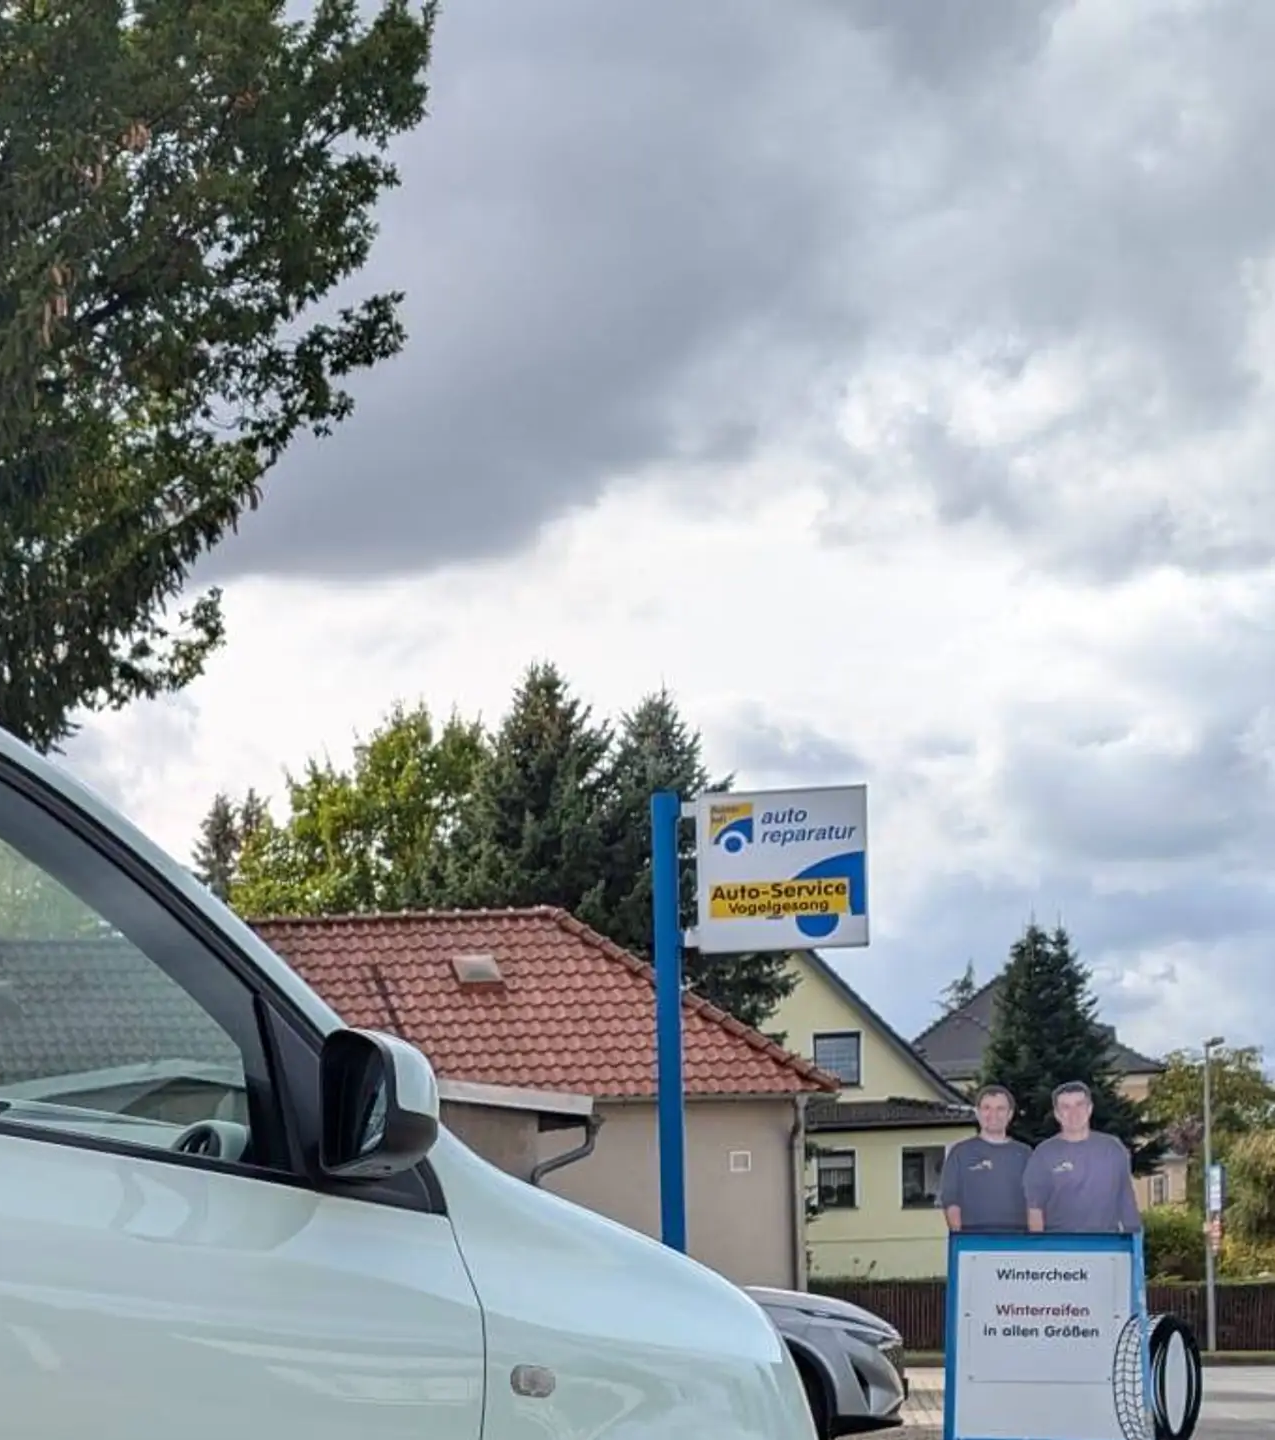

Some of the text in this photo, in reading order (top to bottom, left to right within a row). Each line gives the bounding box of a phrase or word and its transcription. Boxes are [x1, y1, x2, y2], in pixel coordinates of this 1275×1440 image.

[761, 807, 807, 825] auto
[761, 825, 857, 847] reparatur
[711, 880, 847, 901] Auto-Service
[728, 898, 830, 916] Vogelgesang
[995, 1267, 1089, 1281] Wintercheck
[995, 1303, 1091, 1317] Winterreifen
[983, 1324, 1100, 1338] in allen Größen
